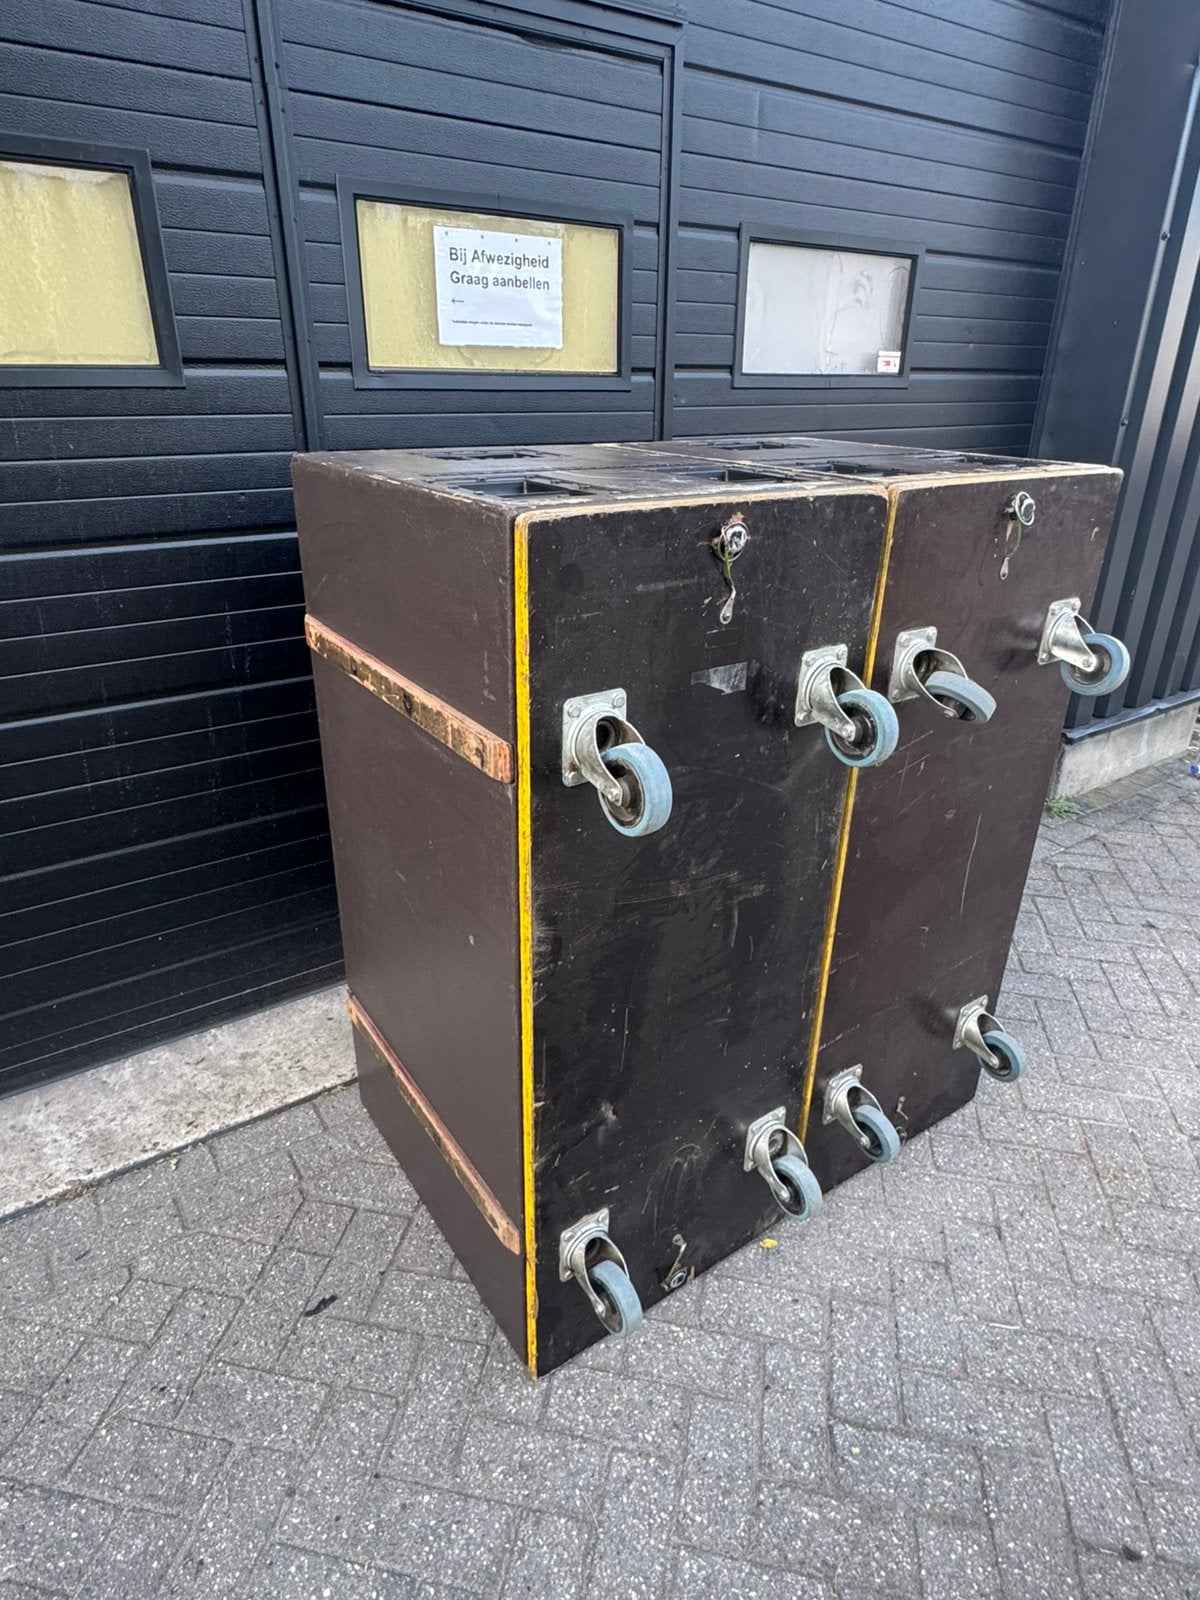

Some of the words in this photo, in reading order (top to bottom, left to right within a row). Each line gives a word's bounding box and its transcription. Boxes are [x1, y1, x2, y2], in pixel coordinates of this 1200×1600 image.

[449, 247, 467, 265] Bij
[471, 249, 549, 270] Afwezigheid
[450, 270, 489, 289] Graag
[492, 275, 550, 290] aanbellen
